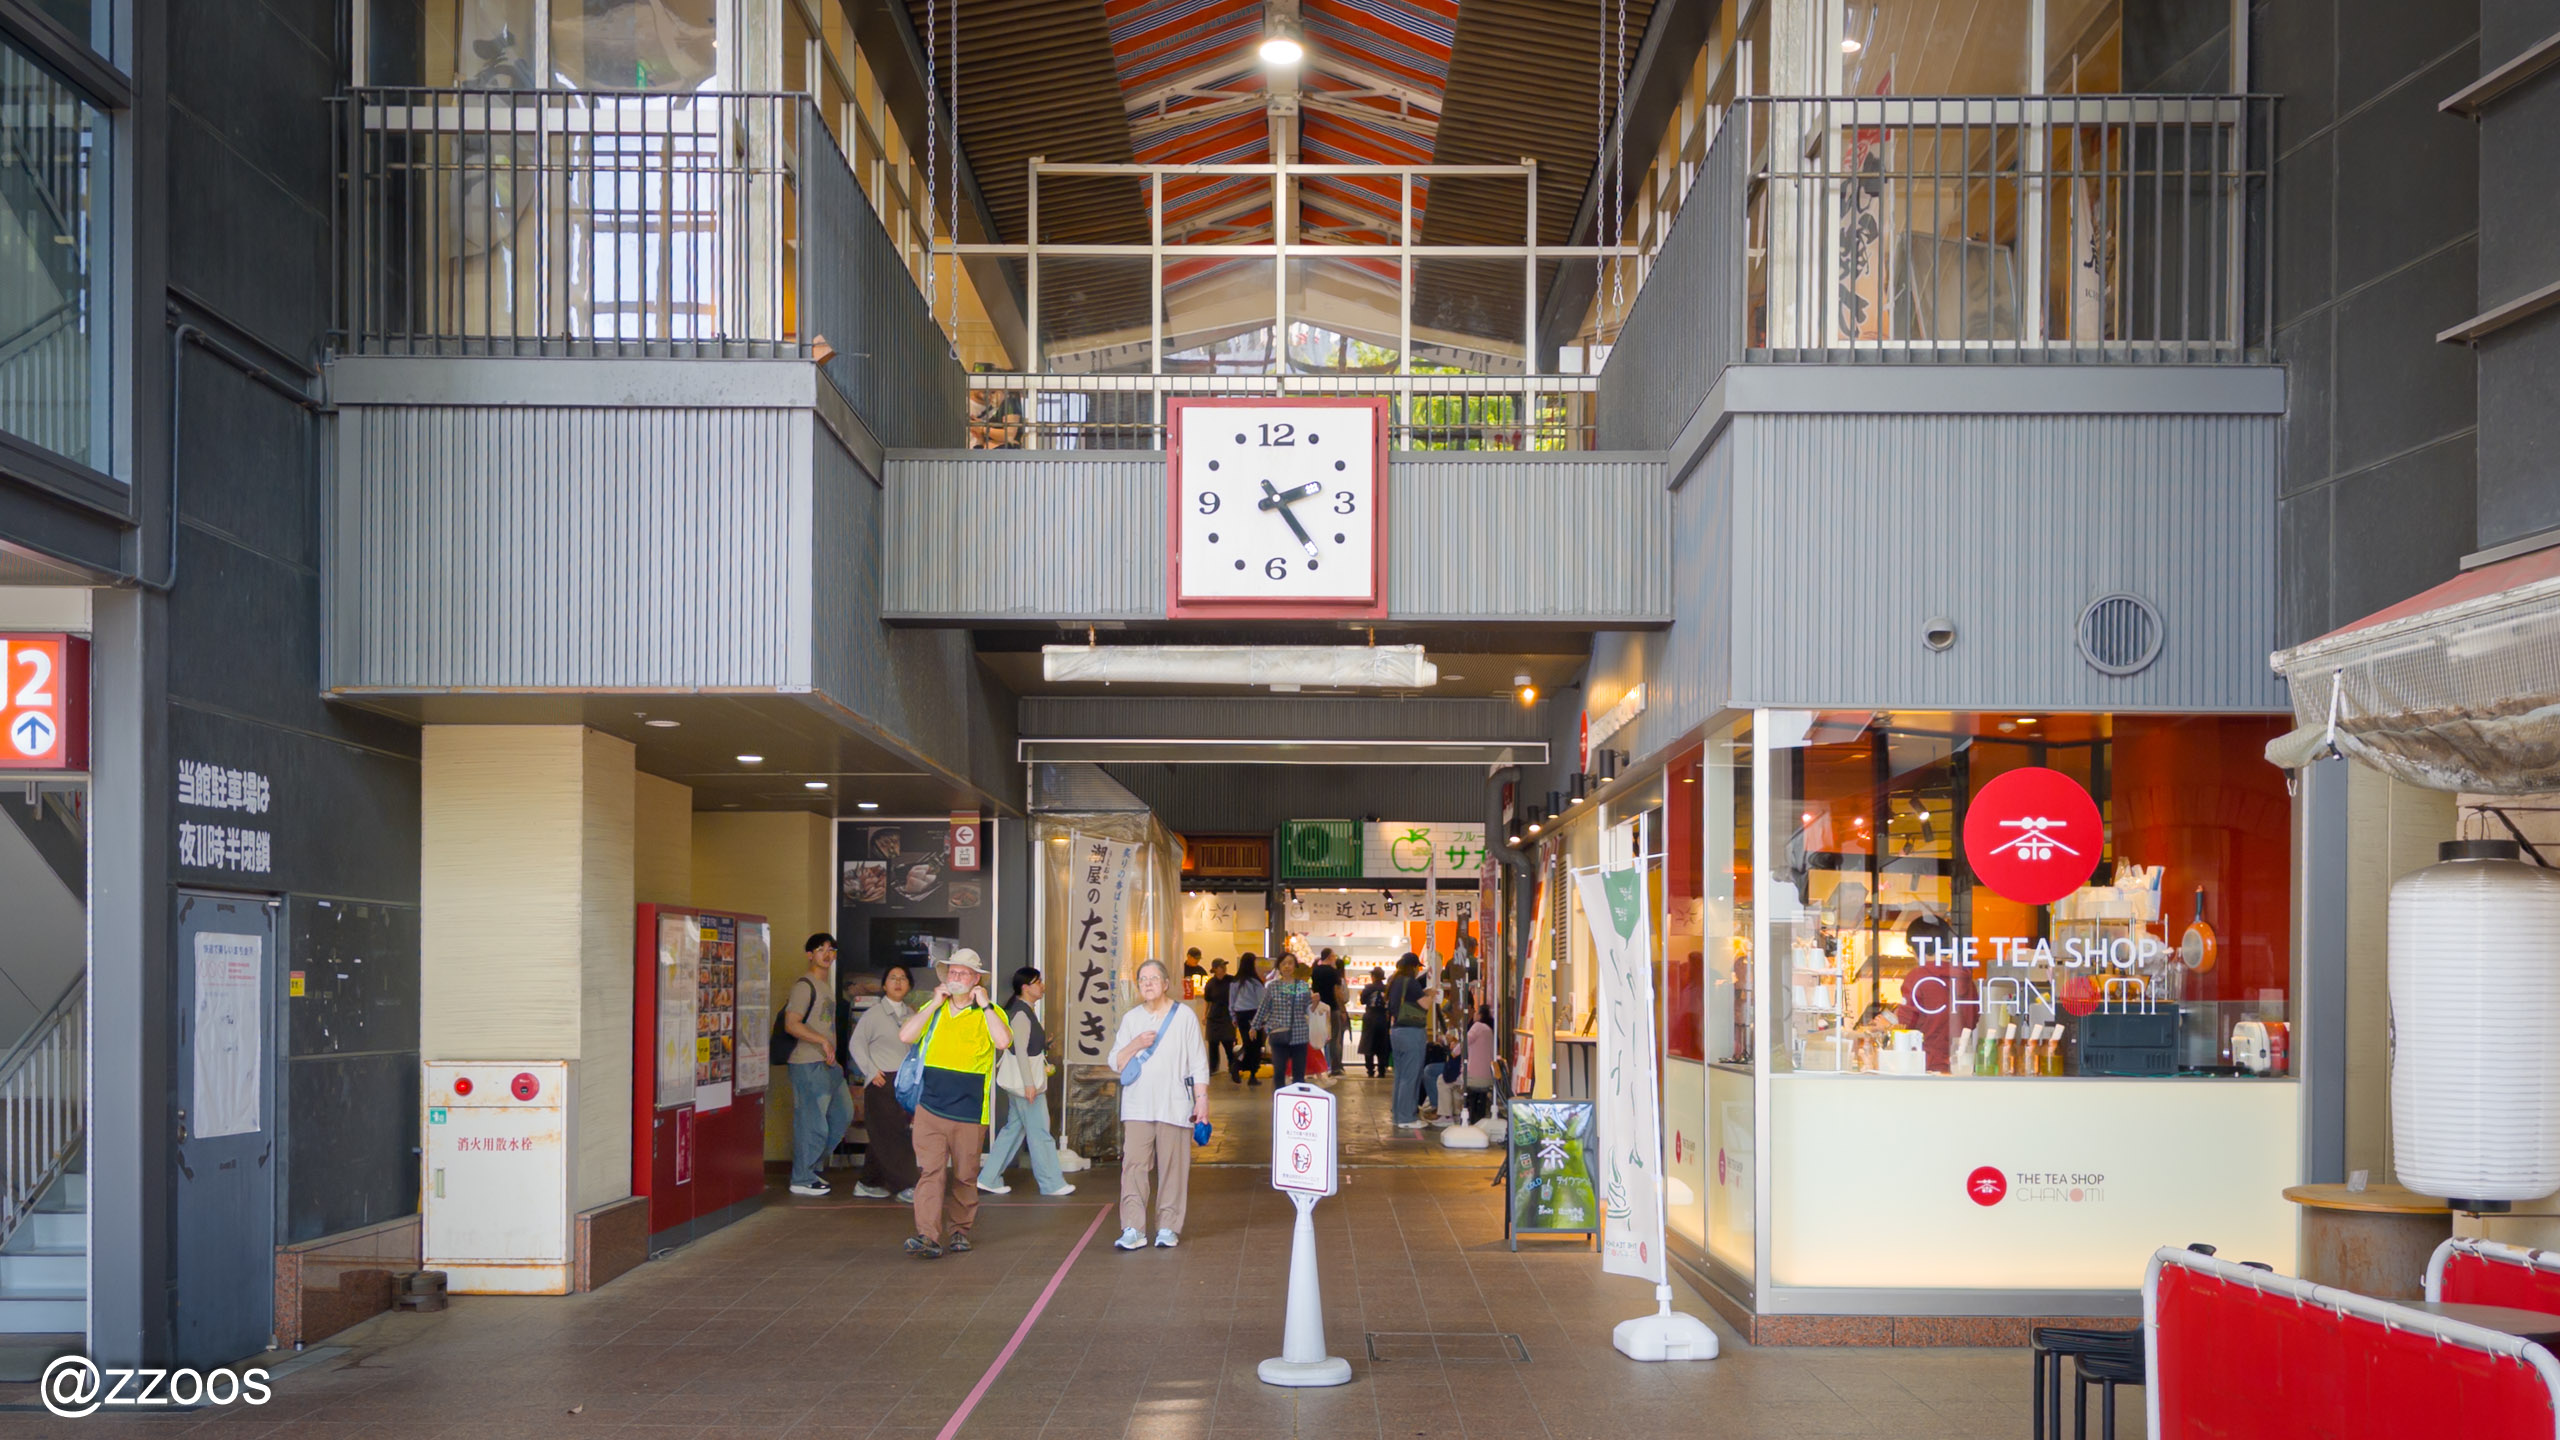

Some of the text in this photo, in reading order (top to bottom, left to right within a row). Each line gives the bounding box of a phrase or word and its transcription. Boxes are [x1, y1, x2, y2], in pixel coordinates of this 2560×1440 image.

[1258, 423, 1295, 446] 12
[1199, 491, 1221, 515] 9
[1333, 491, 1356, 515] 3
[1265, 557, 1287, 580] 6
[178, 759, 270, 814] 当館駐車場は
[178, 820, 271, 873] 夜11時半閉鎖
[1336, 900, 1472, 919] 近江町左衛門
[1077, 843, 1110, 1056] 潮屋のたたき
[1911, 937, 2158, 968] THE TEA SHOP
[457, 1137, 533, 1151] 消火用散水栓
[1537, 1137, 1569, 1169] 茶
[2016, 1173, 2105, 1185] THE TEA SHOP
